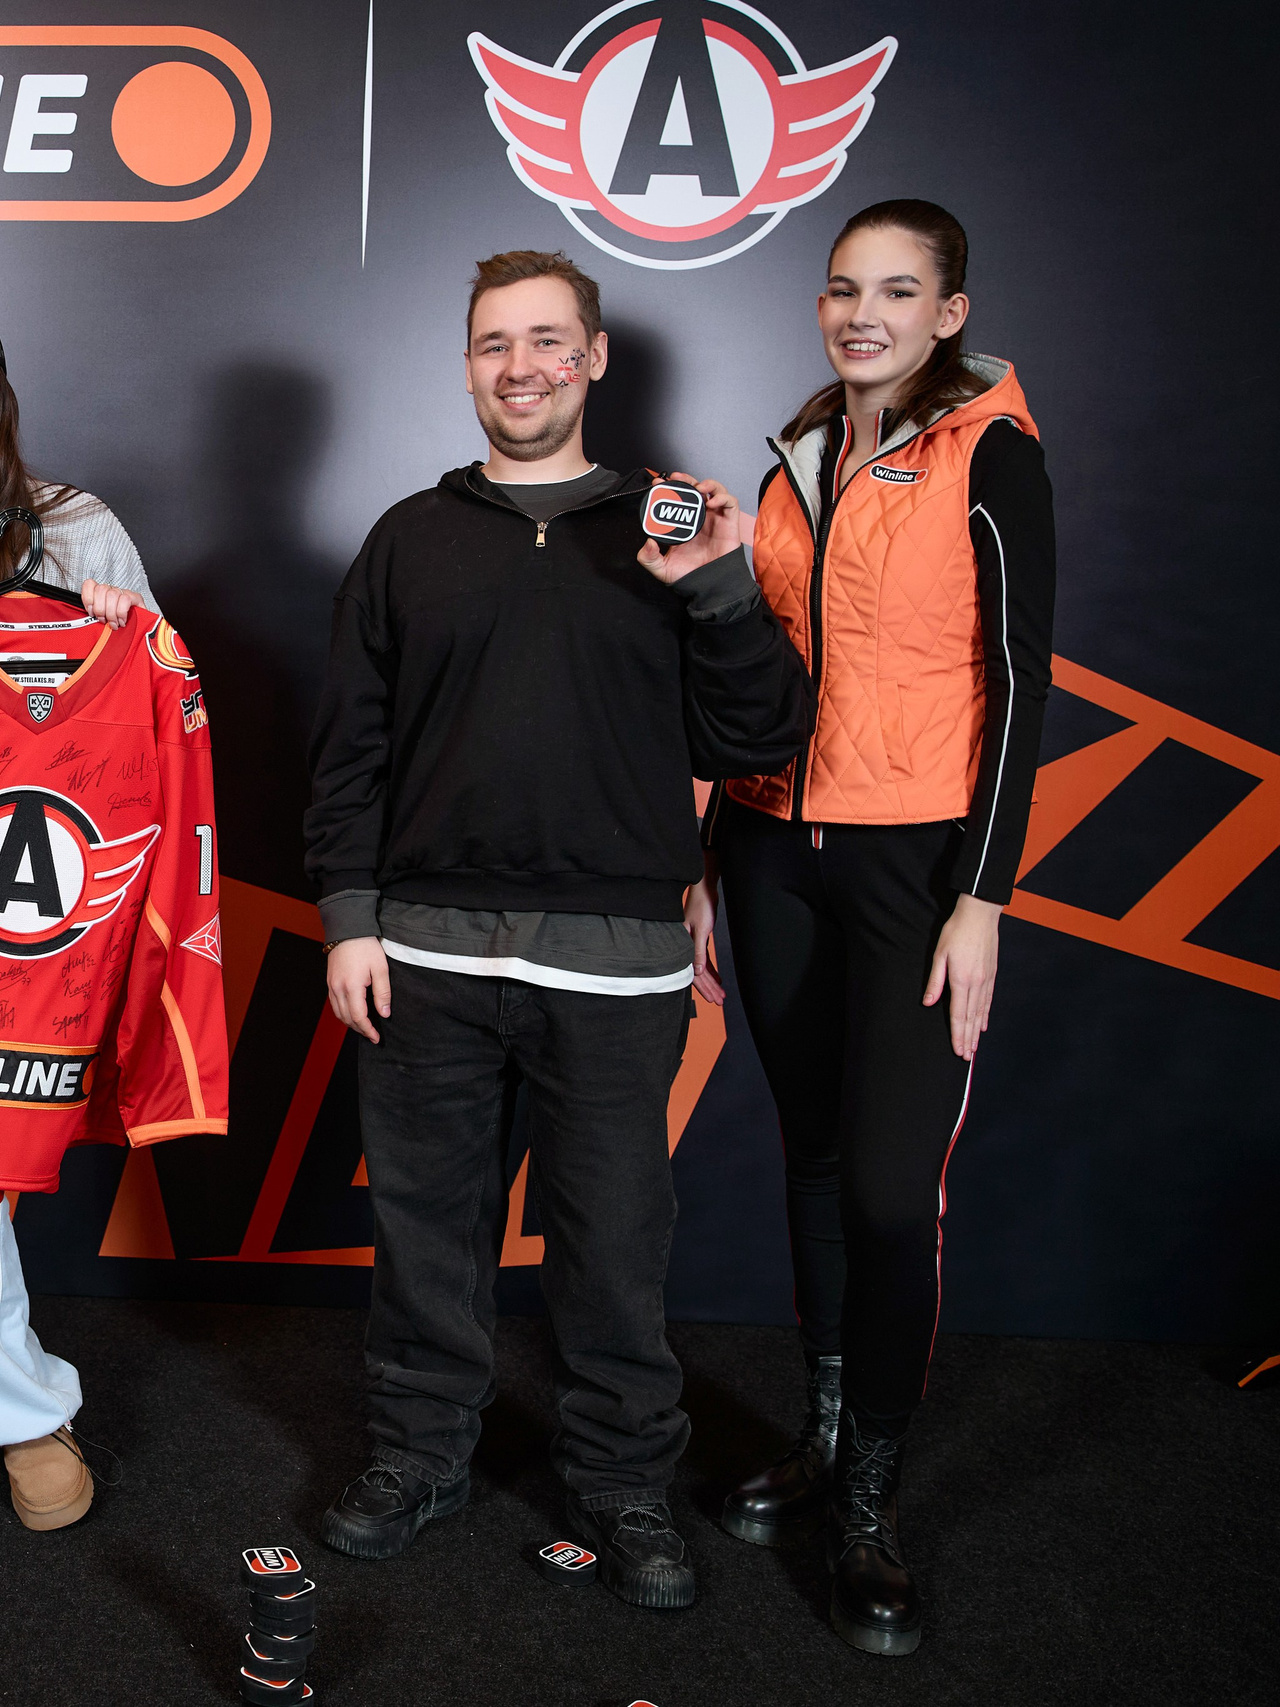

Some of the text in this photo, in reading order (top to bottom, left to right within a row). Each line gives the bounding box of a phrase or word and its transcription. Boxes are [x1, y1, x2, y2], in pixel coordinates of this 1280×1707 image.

[875, 467, 914, 481] Winline
[659, 504, 695, 523] WIN
[553, 1549, 578, 1563] WIN
